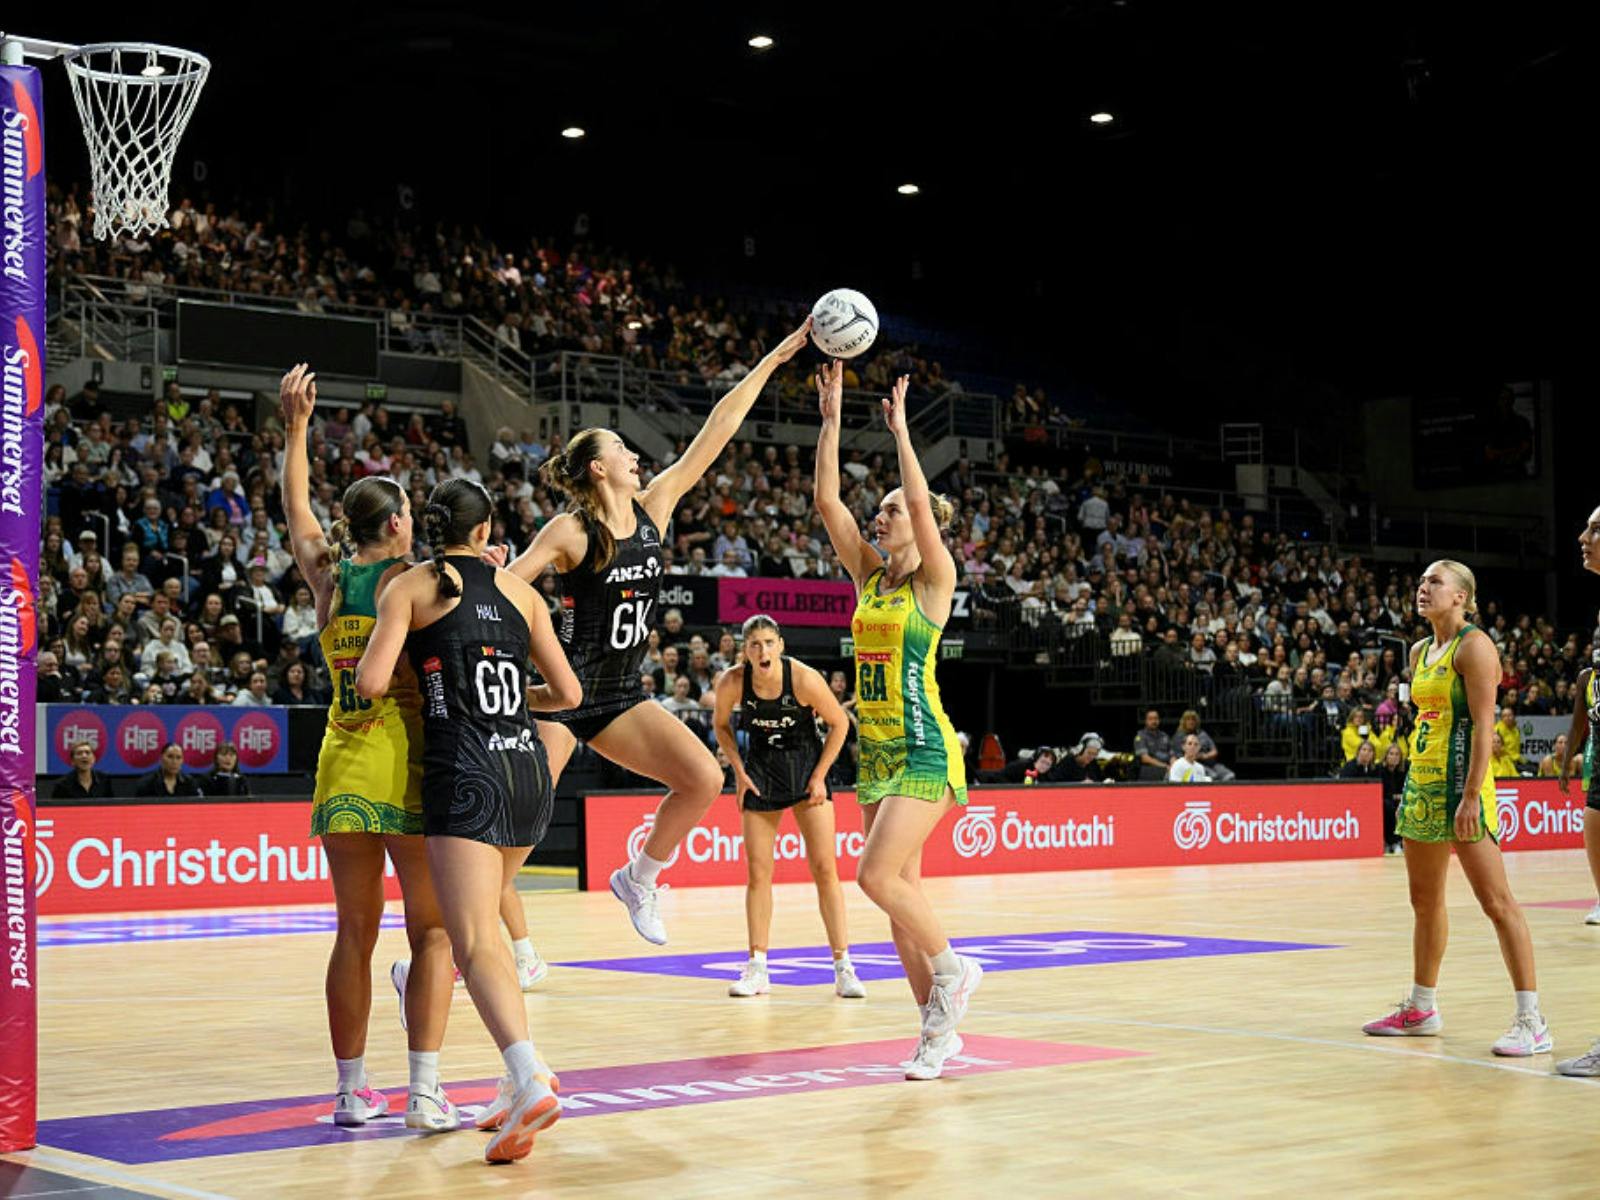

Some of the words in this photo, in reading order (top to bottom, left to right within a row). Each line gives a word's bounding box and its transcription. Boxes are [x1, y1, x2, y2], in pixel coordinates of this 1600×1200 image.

[3, 107, 29, 281] Summerset
[2, 345, 30, 517] Summerset
[606, 565, 644, 584] ANZ
[475, 603, 502, 621] HALL
[658, 585, 694, 605] edia
[756, 590, 850, 614] GILBERT
[610, 598, 653, 649] GK
[0, 585, 26, 756] Summerset
[475, 659, 522, 716] GD
[859, 662, 889, 702] GA
[1002, 811, 1114, 850] Ōtautahi
[1216, 809, 1360, 844] Christchurch
[1523, 800, 1585, 835] Chris
[67, 834, 396, 889] Christchu
[2, 817, 32, 989] Summerset
